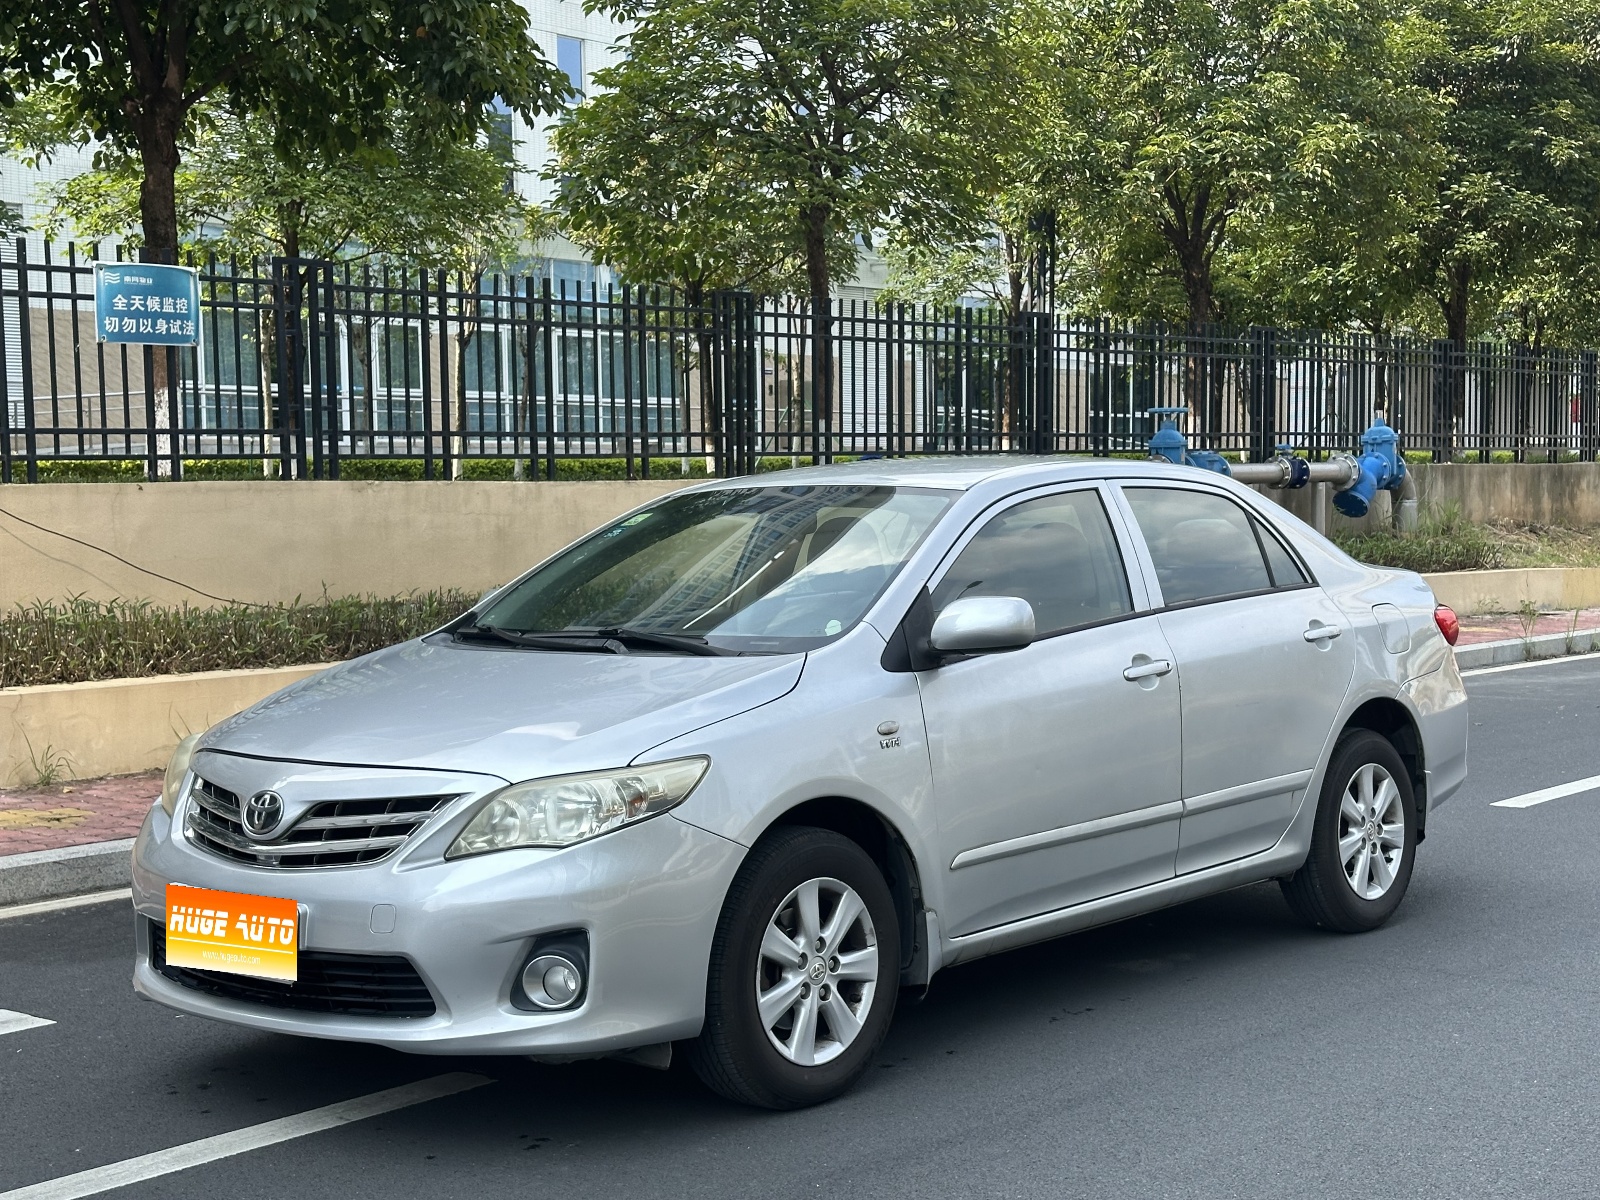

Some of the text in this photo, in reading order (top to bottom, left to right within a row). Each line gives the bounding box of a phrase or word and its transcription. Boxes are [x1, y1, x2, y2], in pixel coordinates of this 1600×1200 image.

[112, 294, 189, 314] 全天候监控
[104, 316, 195, 336] 切勿以身试法
